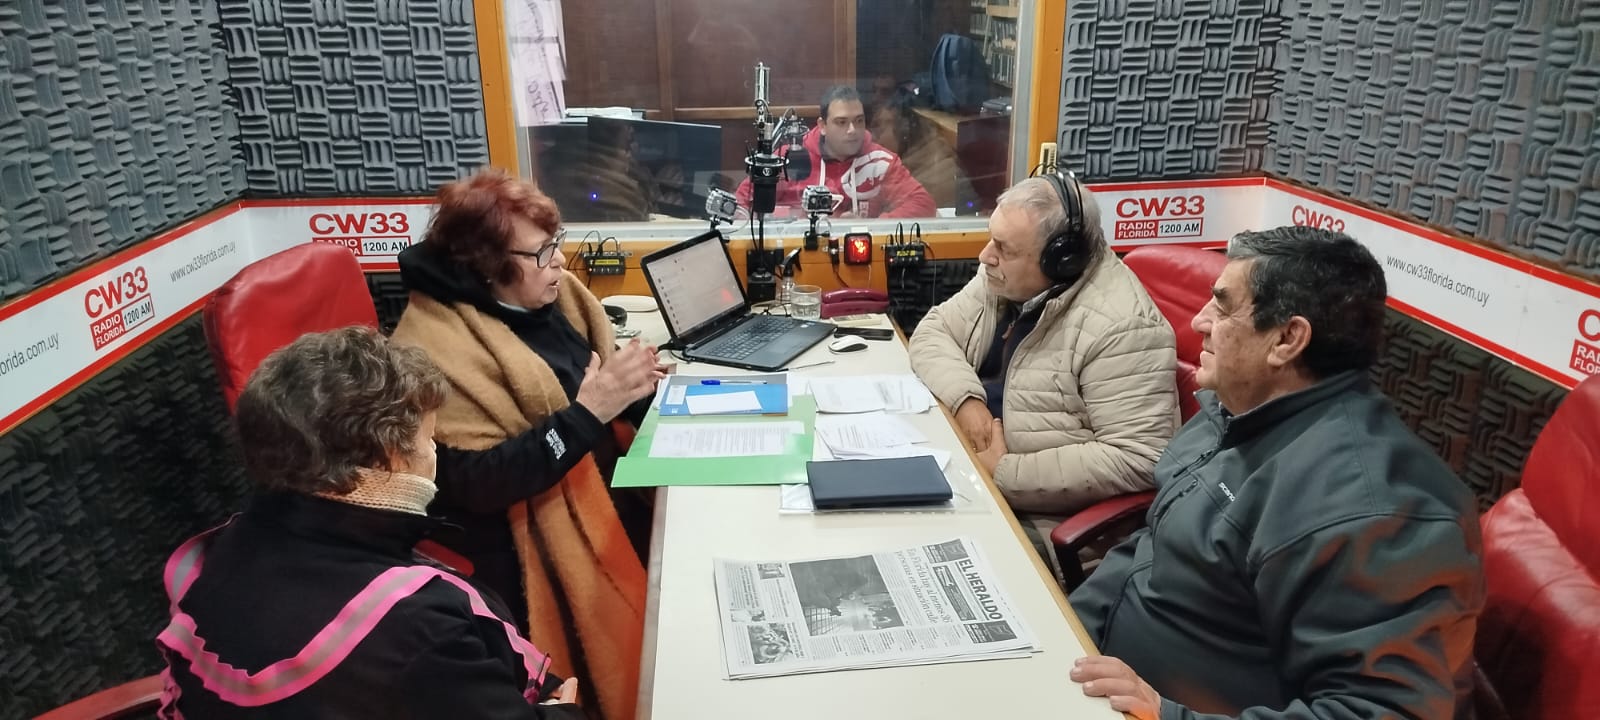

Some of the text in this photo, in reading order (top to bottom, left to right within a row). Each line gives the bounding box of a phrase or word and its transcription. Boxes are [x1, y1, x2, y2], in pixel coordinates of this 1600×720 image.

[1116, 195, 1205, 218] CW33
[309, 212, 410, 235] CW33
[1118, 221, 1156, 231] RADIO
[1118, 230, 1156, 239] FLORIDA
[1160, 223, 1200, 233] 1200 AM
[363, 241, 408, 251] 1200 AM
[85, 266, 149, 318] CW33
[1387, 255, 1490, 308] www.cw33florida.com.uy
[93, 313, 121, 337] RADIO
[124, 301, 151, 326] 1200 AM
[95, 324, 125, 347] FLORIDA
[958, 559, 974, 572] EL
[965, 572, 1004, 620] HERALDO
